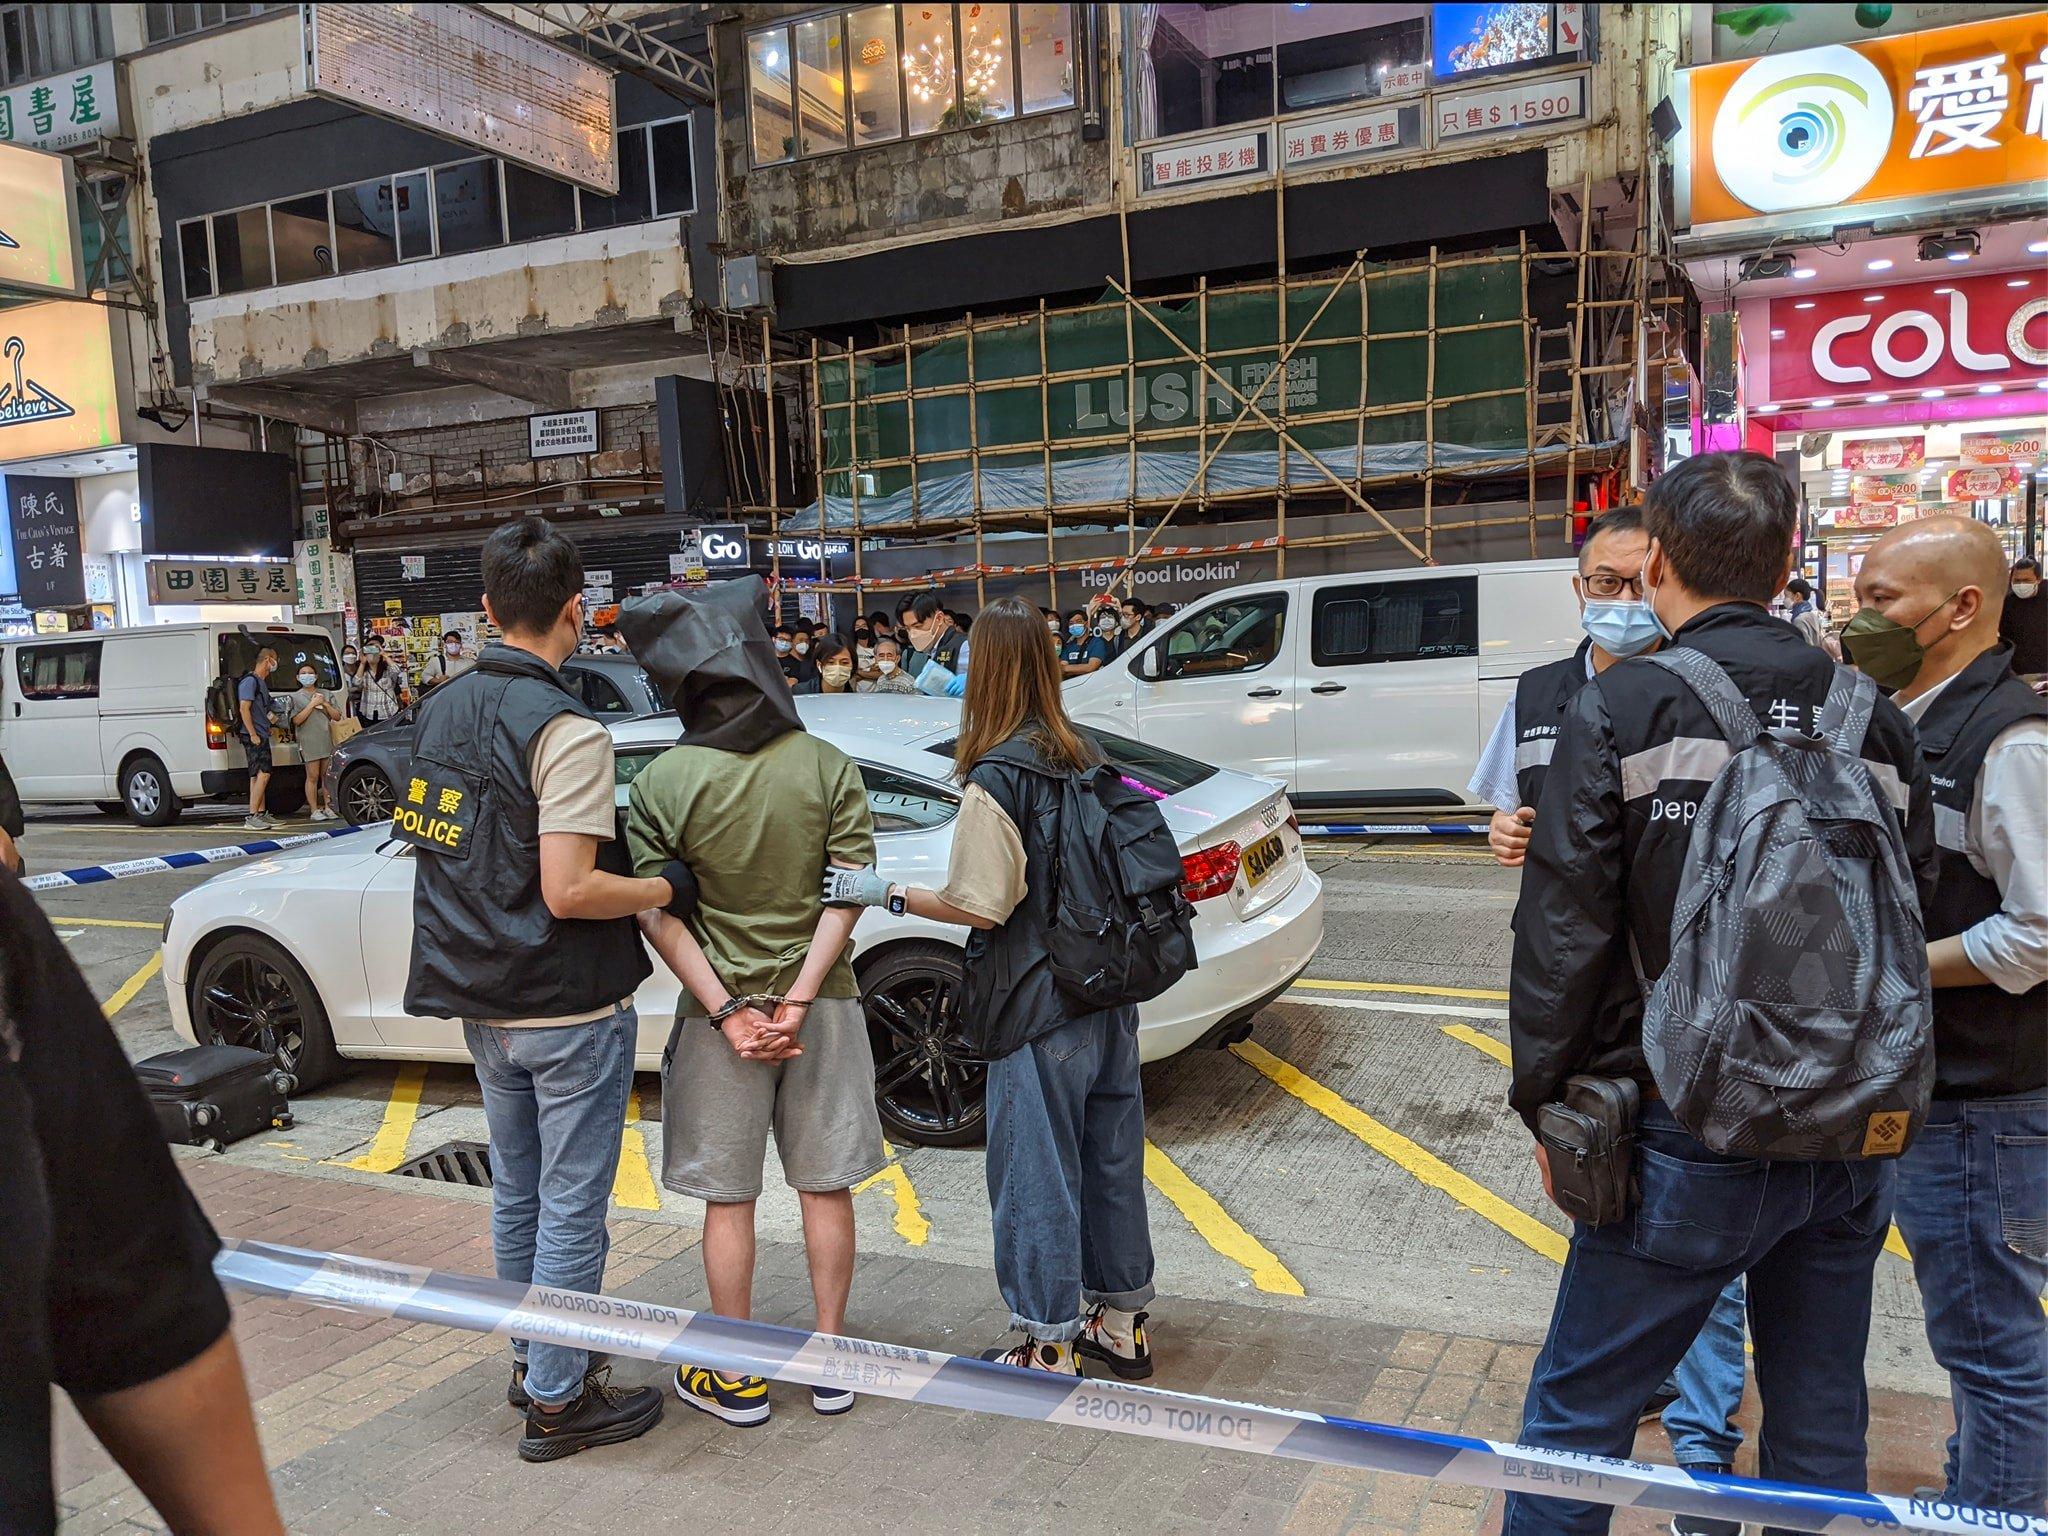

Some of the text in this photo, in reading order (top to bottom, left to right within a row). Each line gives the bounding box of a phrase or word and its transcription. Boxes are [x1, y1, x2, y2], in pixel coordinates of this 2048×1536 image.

[1383, 70, 1424, 90] 示範中
[1441, 95, 1571, 134] 只售$1590
[1287, 121, 1398, 160] 消費券優惠
[1155, 147, 1257, 181] 智能投影機
[1241, 356, 1317, 384] FRESH
[1075, 366, 1233, 429] LUSH
[1241, 378, 1317, 398] HANDADE
[1246, 392, 1317, 410] OSMTICS
[20, 491, 65, 520] 陳氏
[768, 542, 794, 555] SLON
[166, 567, 291, 595] 田園書屋
[1081, 563, 1119, 591] Hey
[1175, 560, 1241, 582] lookin'
[1930, 773, 1956, 789] lcohol
[407, 777, 463, 815] 警察
[393, 806, 463, 847] POLICE
